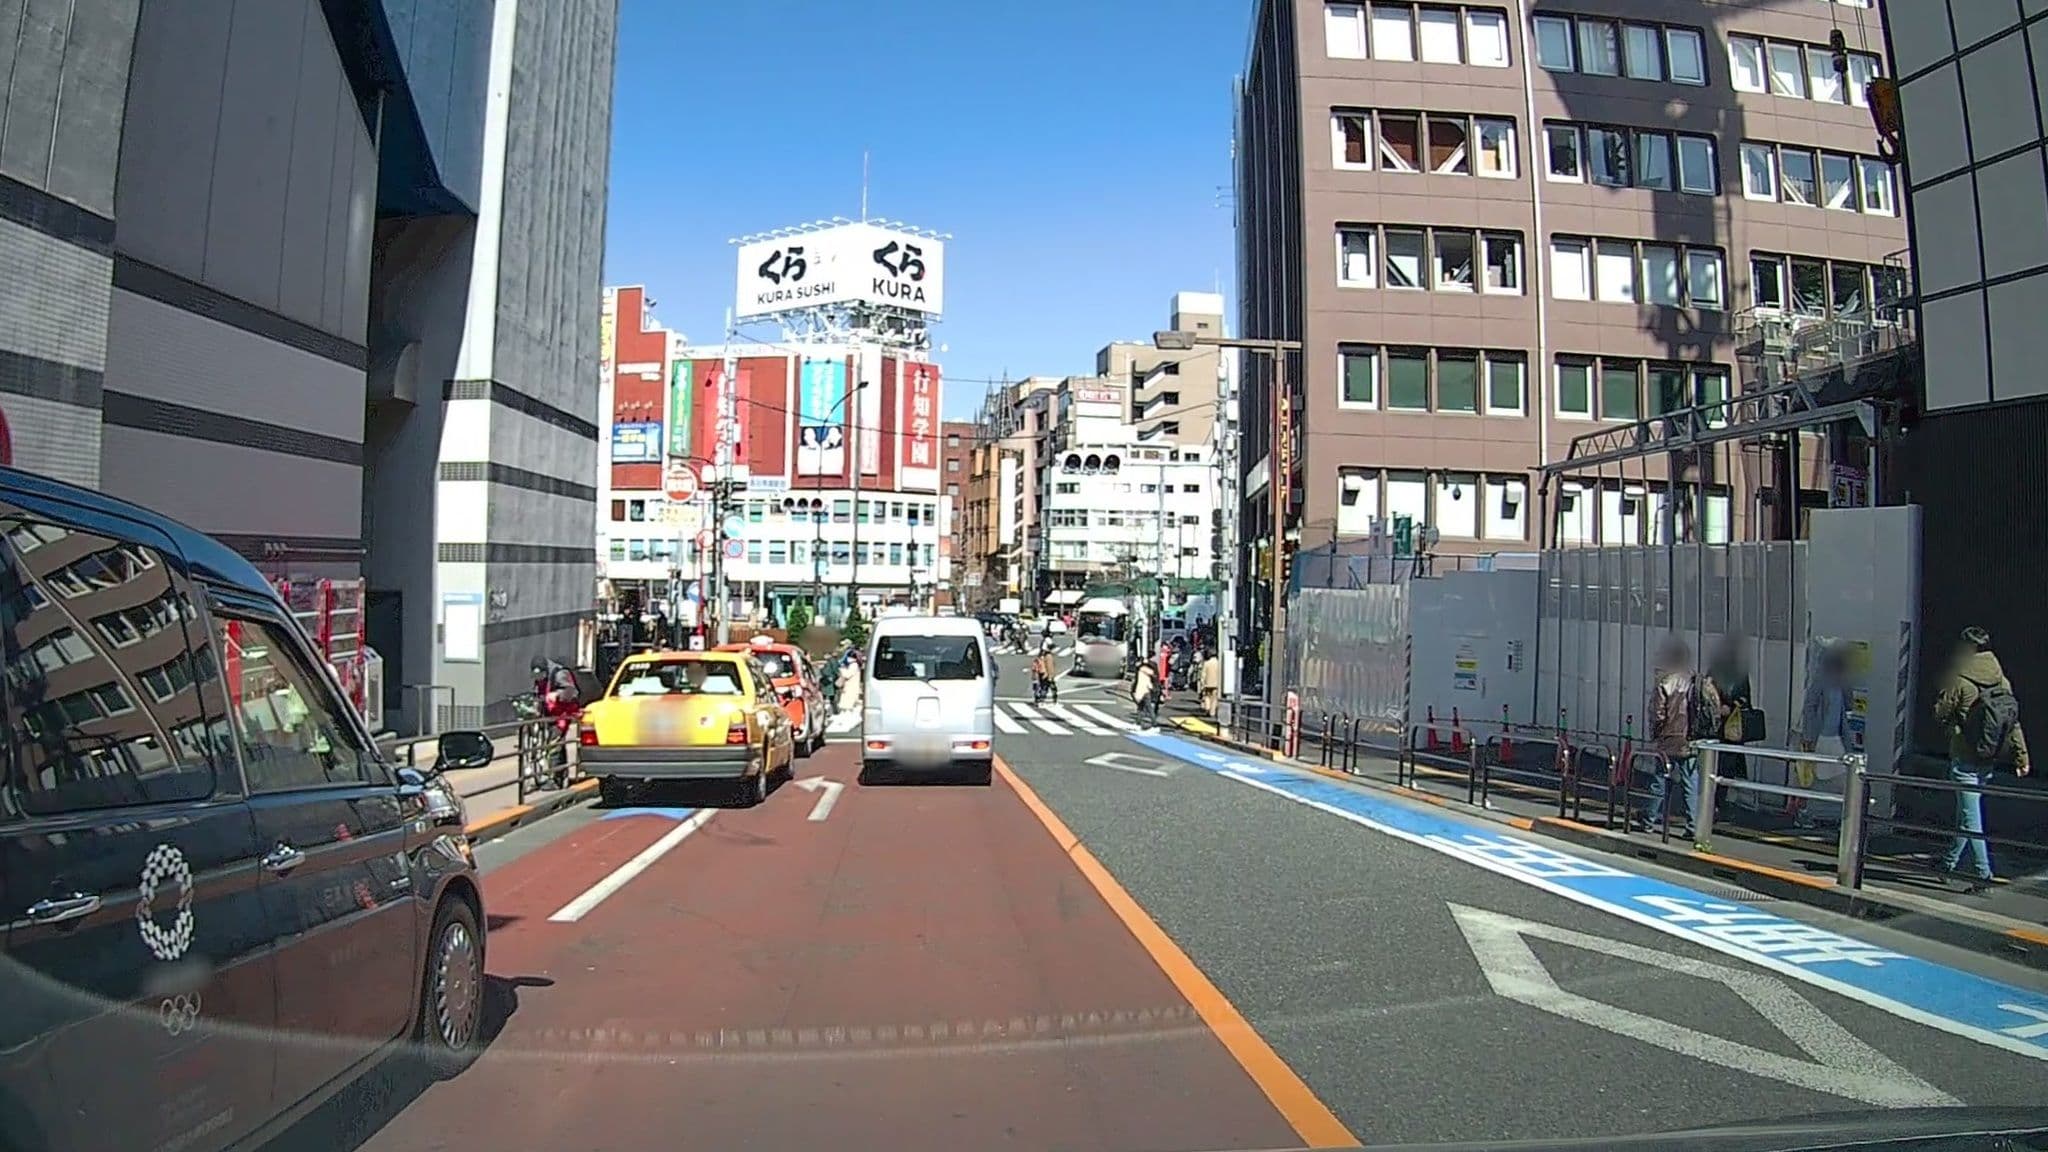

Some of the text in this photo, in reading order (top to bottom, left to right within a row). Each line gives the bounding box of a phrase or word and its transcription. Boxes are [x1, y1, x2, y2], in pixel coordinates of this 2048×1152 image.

[758, 246, 807, 285] くら
[873, 240, 926, 282] くら
[757, 282, 835, 305] KURA SUSHI
[873, 277, 926, 303] KURA
